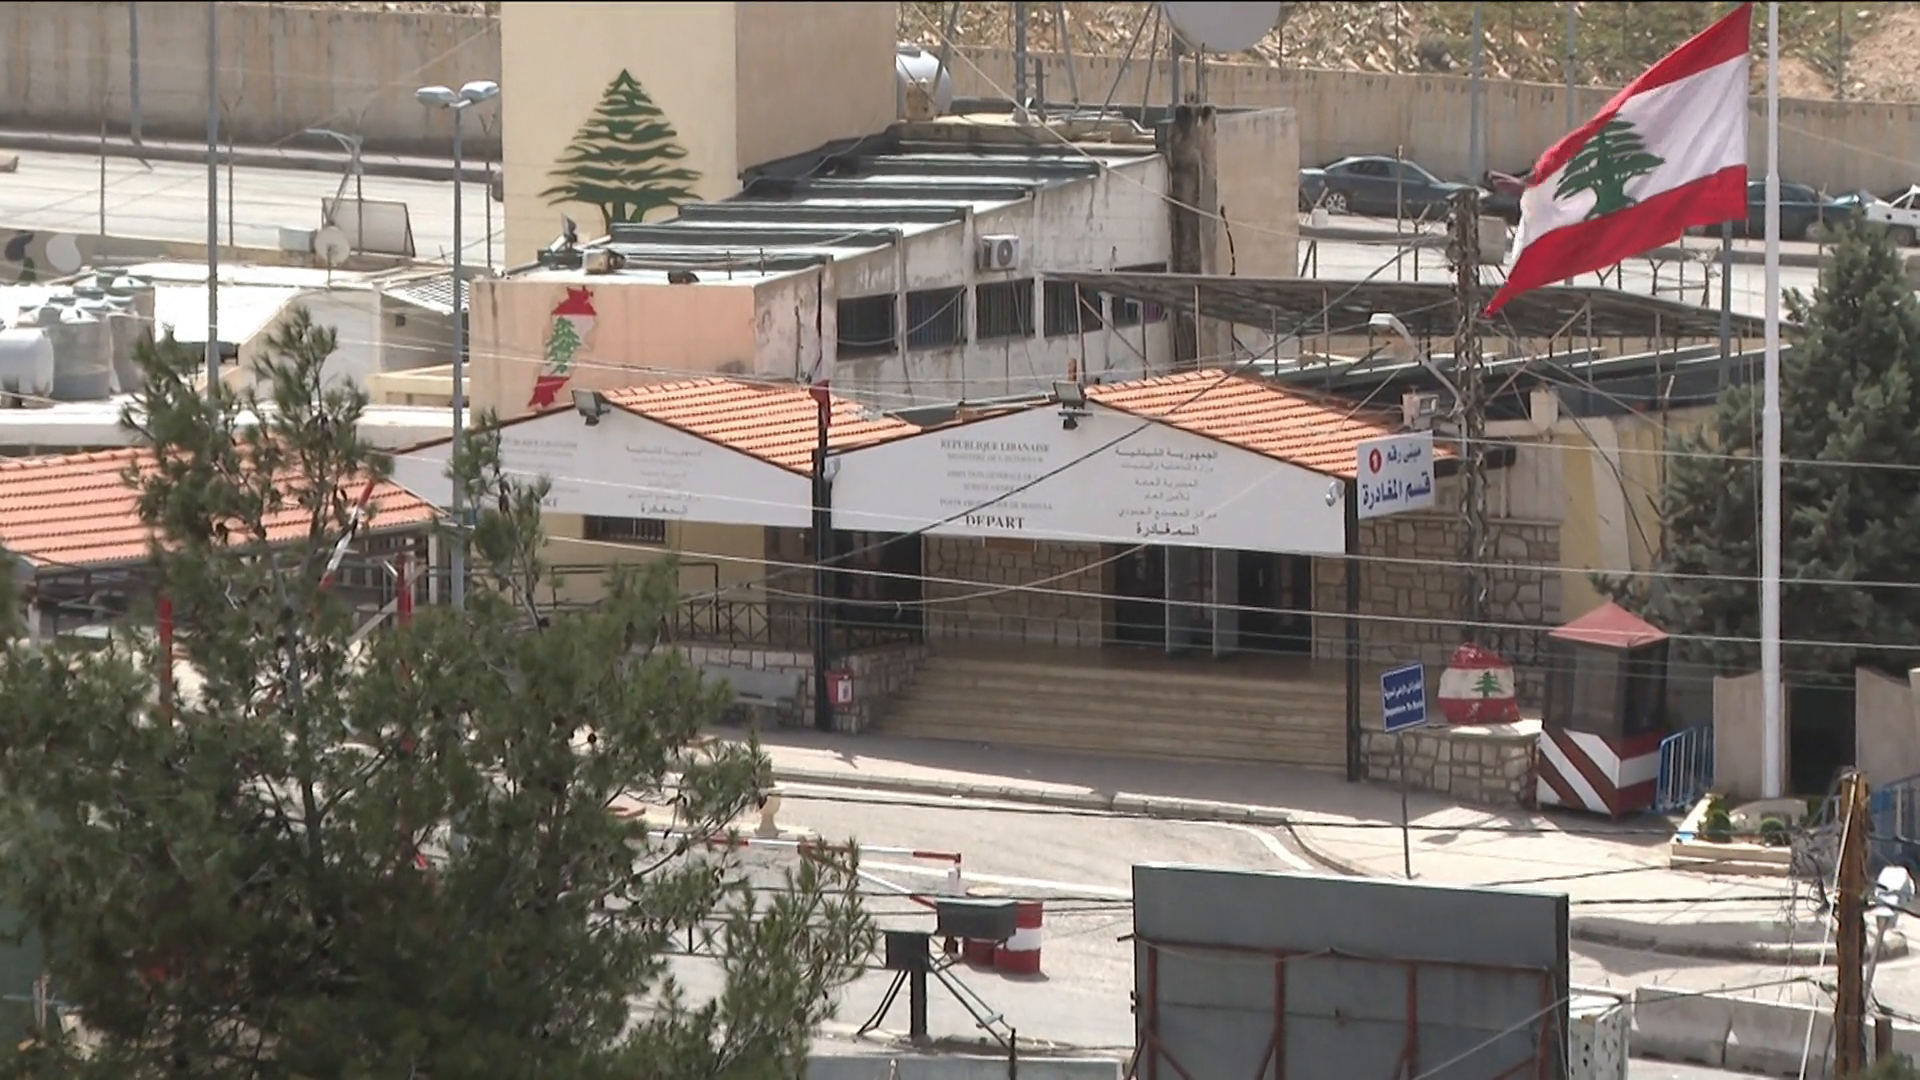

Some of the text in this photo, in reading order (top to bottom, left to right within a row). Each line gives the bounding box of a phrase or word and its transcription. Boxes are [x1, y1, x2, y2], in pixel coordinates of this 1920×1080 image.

[1362, 471, 1431, 510] قسم المغادرة
[965, 514, 1025, 530] DEPART
[1136, 521, 1200, 538] المغادرة
